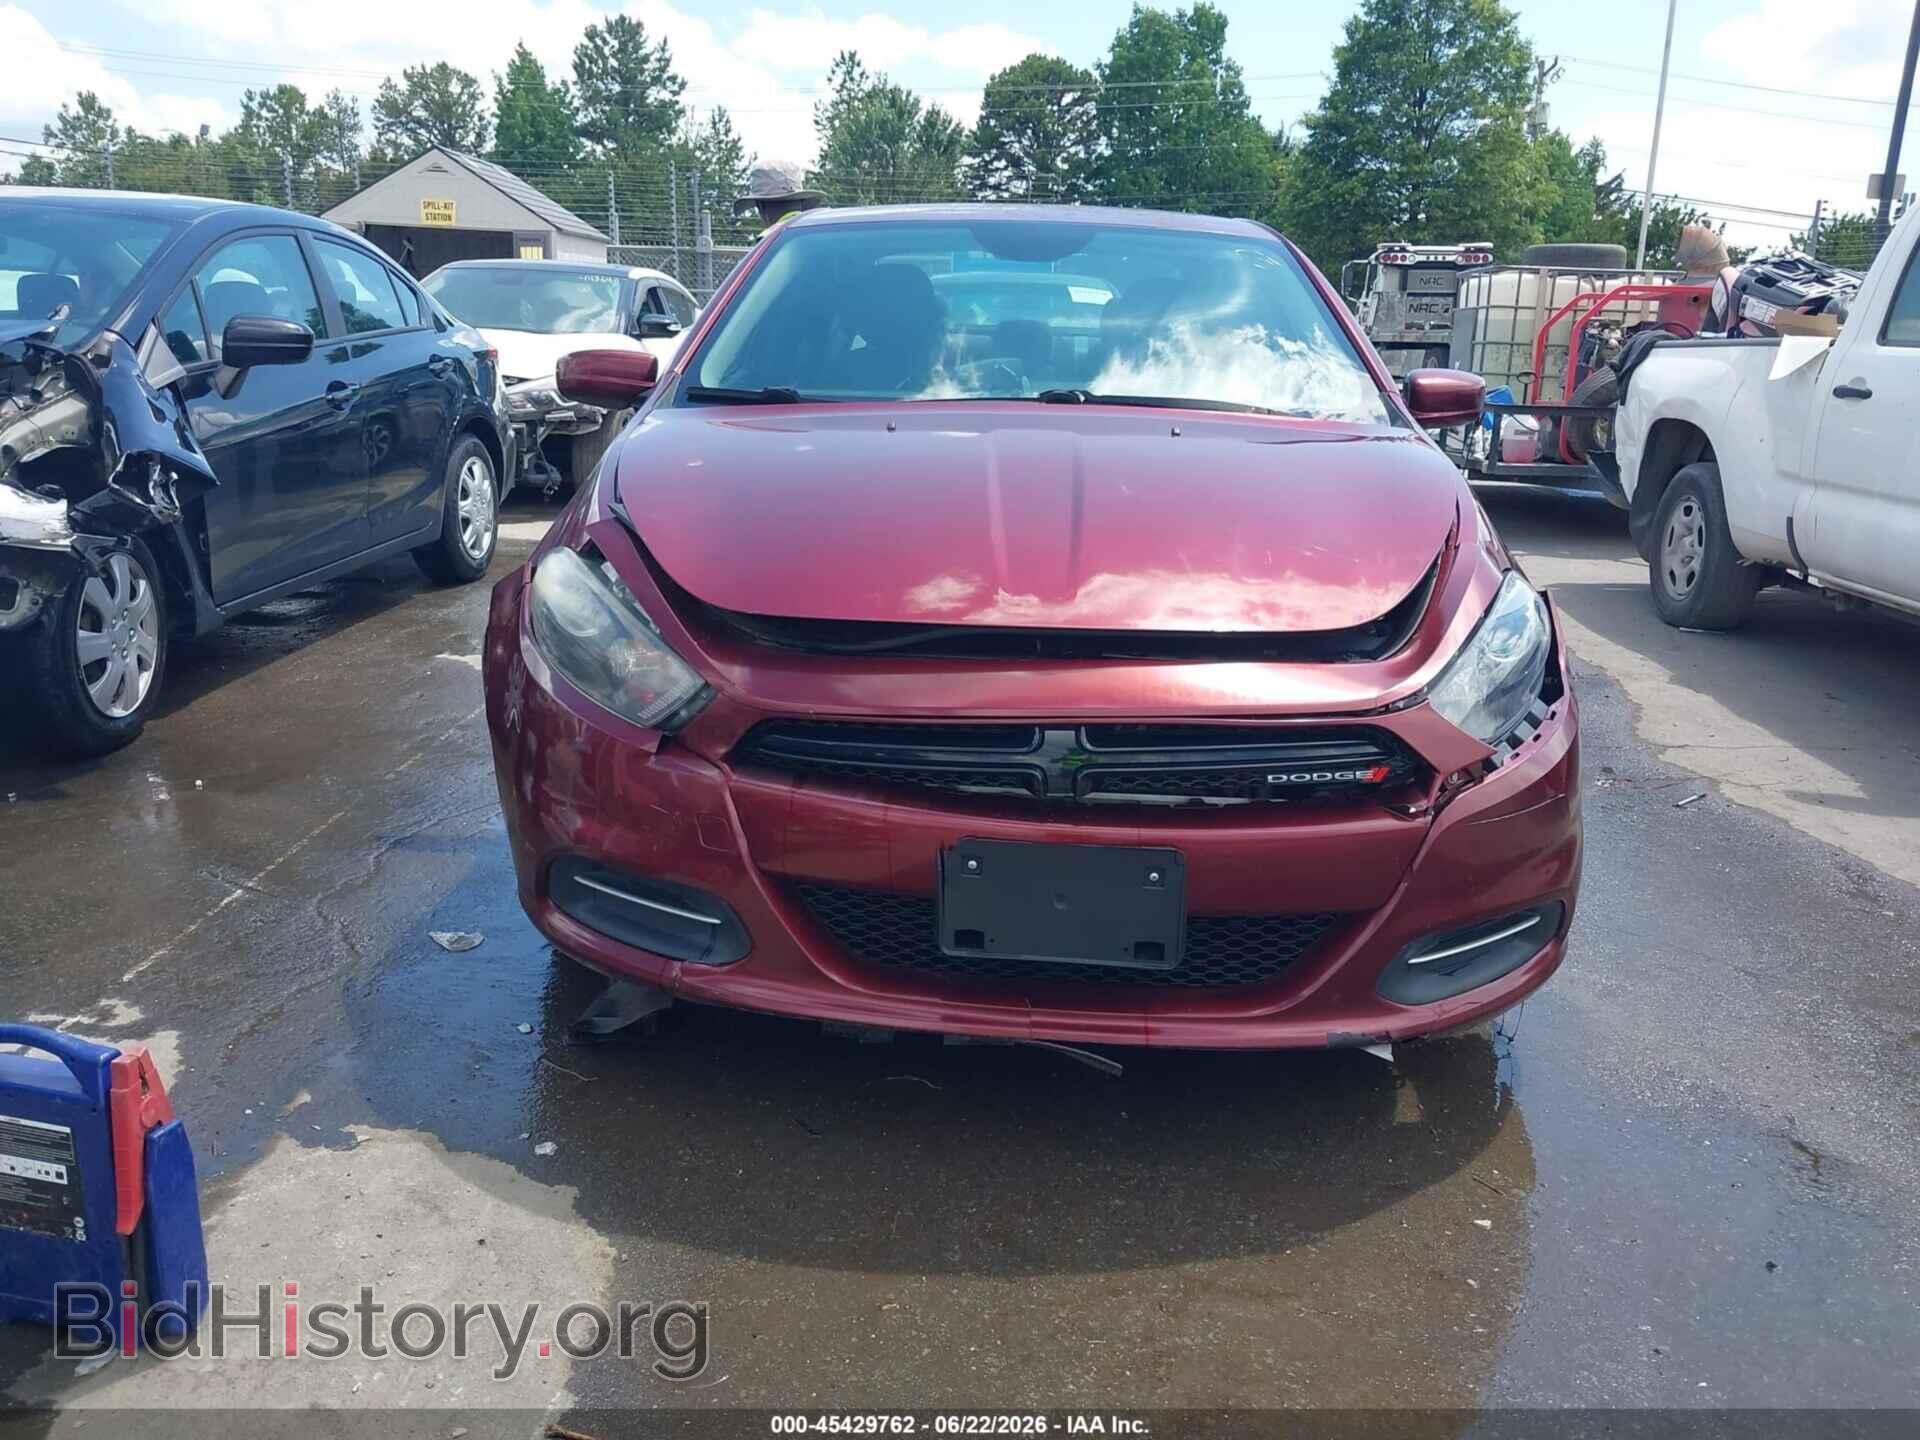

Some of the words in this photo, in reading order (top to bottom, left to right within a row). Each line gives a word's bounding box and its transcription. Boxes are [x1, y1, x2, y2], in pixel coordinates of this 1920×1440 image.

[422, 200, 454, 210] SPILL-KIT
[425, 212, 452, 221] STATION
[1419, 276, 1445, 286] NRC
[1408, 303, 1439, 313] NRC
[1267, 770, 1374, 783] DODGE
